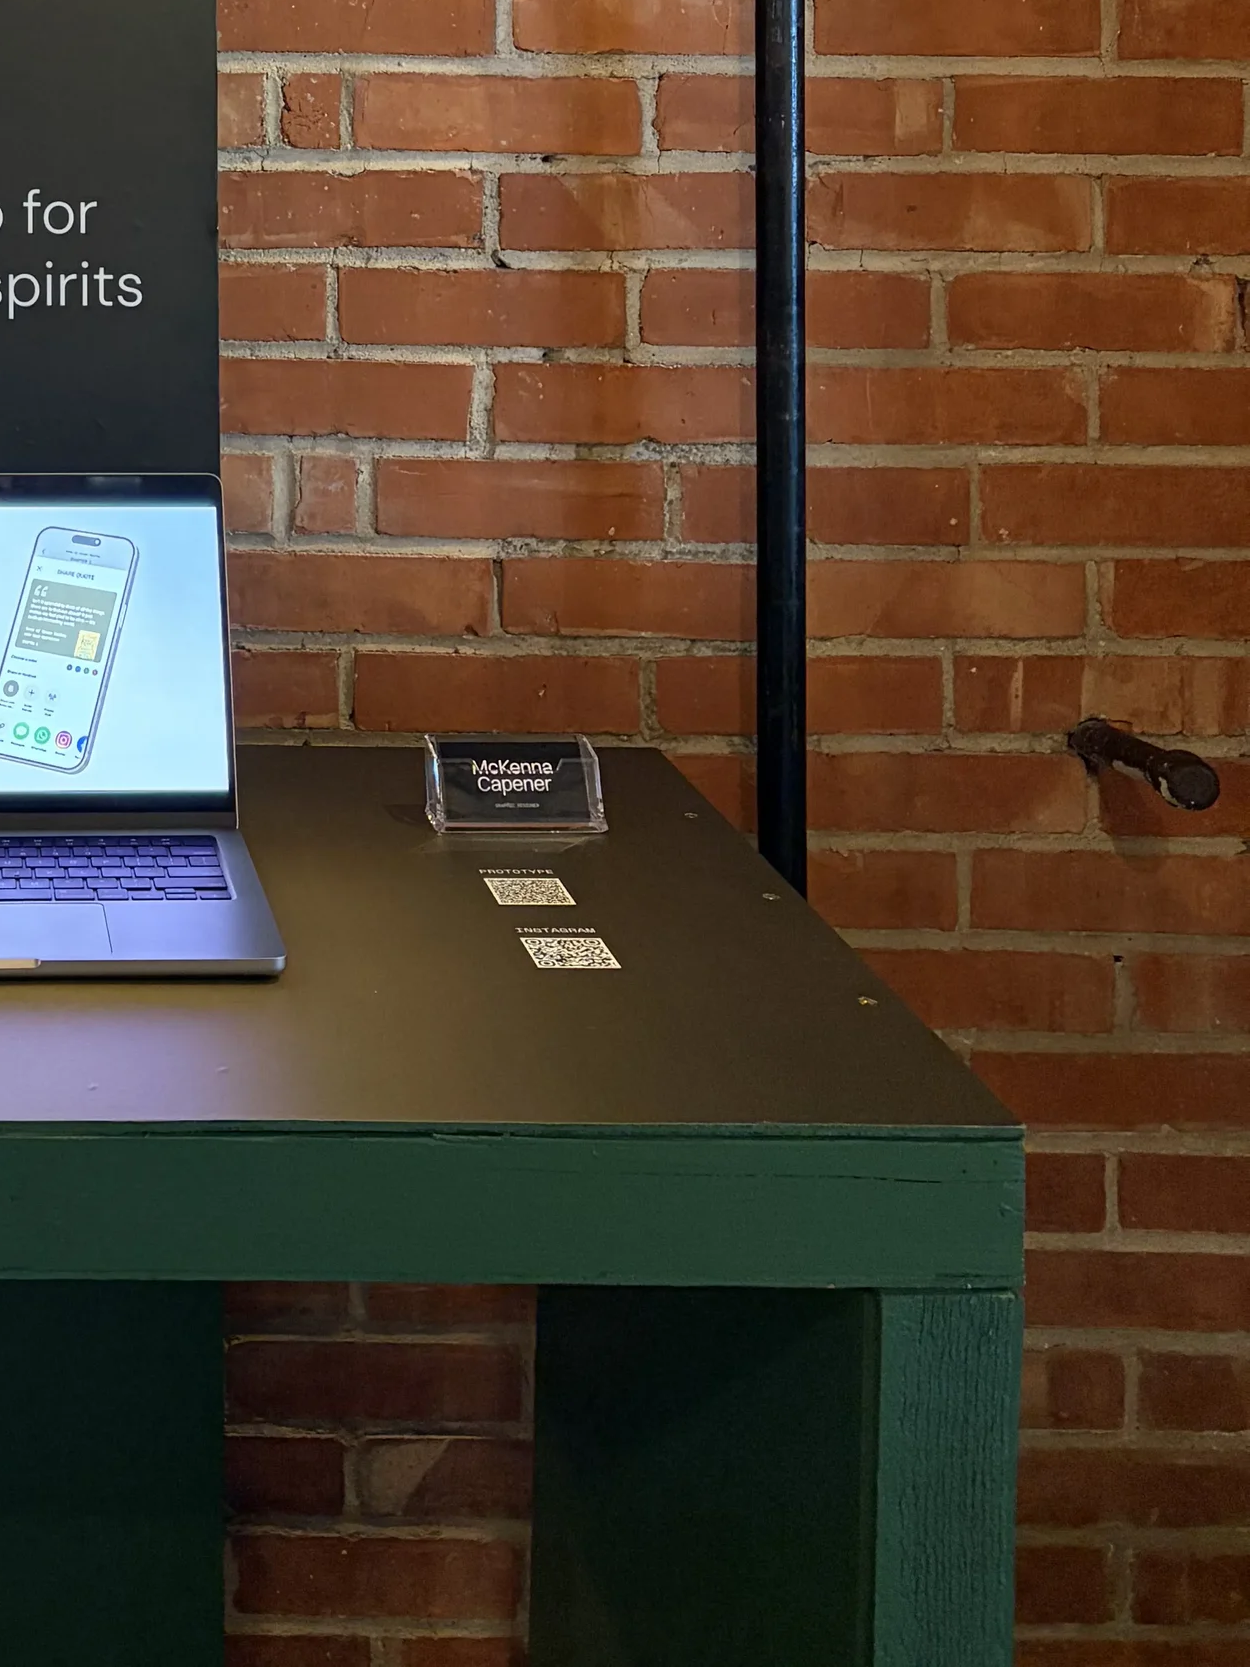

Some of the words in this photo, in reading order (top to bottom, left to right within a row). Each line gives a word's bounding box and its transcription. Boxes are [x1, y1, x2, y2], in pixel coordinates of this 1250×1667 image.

[22, 188, 98, 235] for
[472, 759, 554, 775] McKenna
[477, 776, 552, 796] Capener
